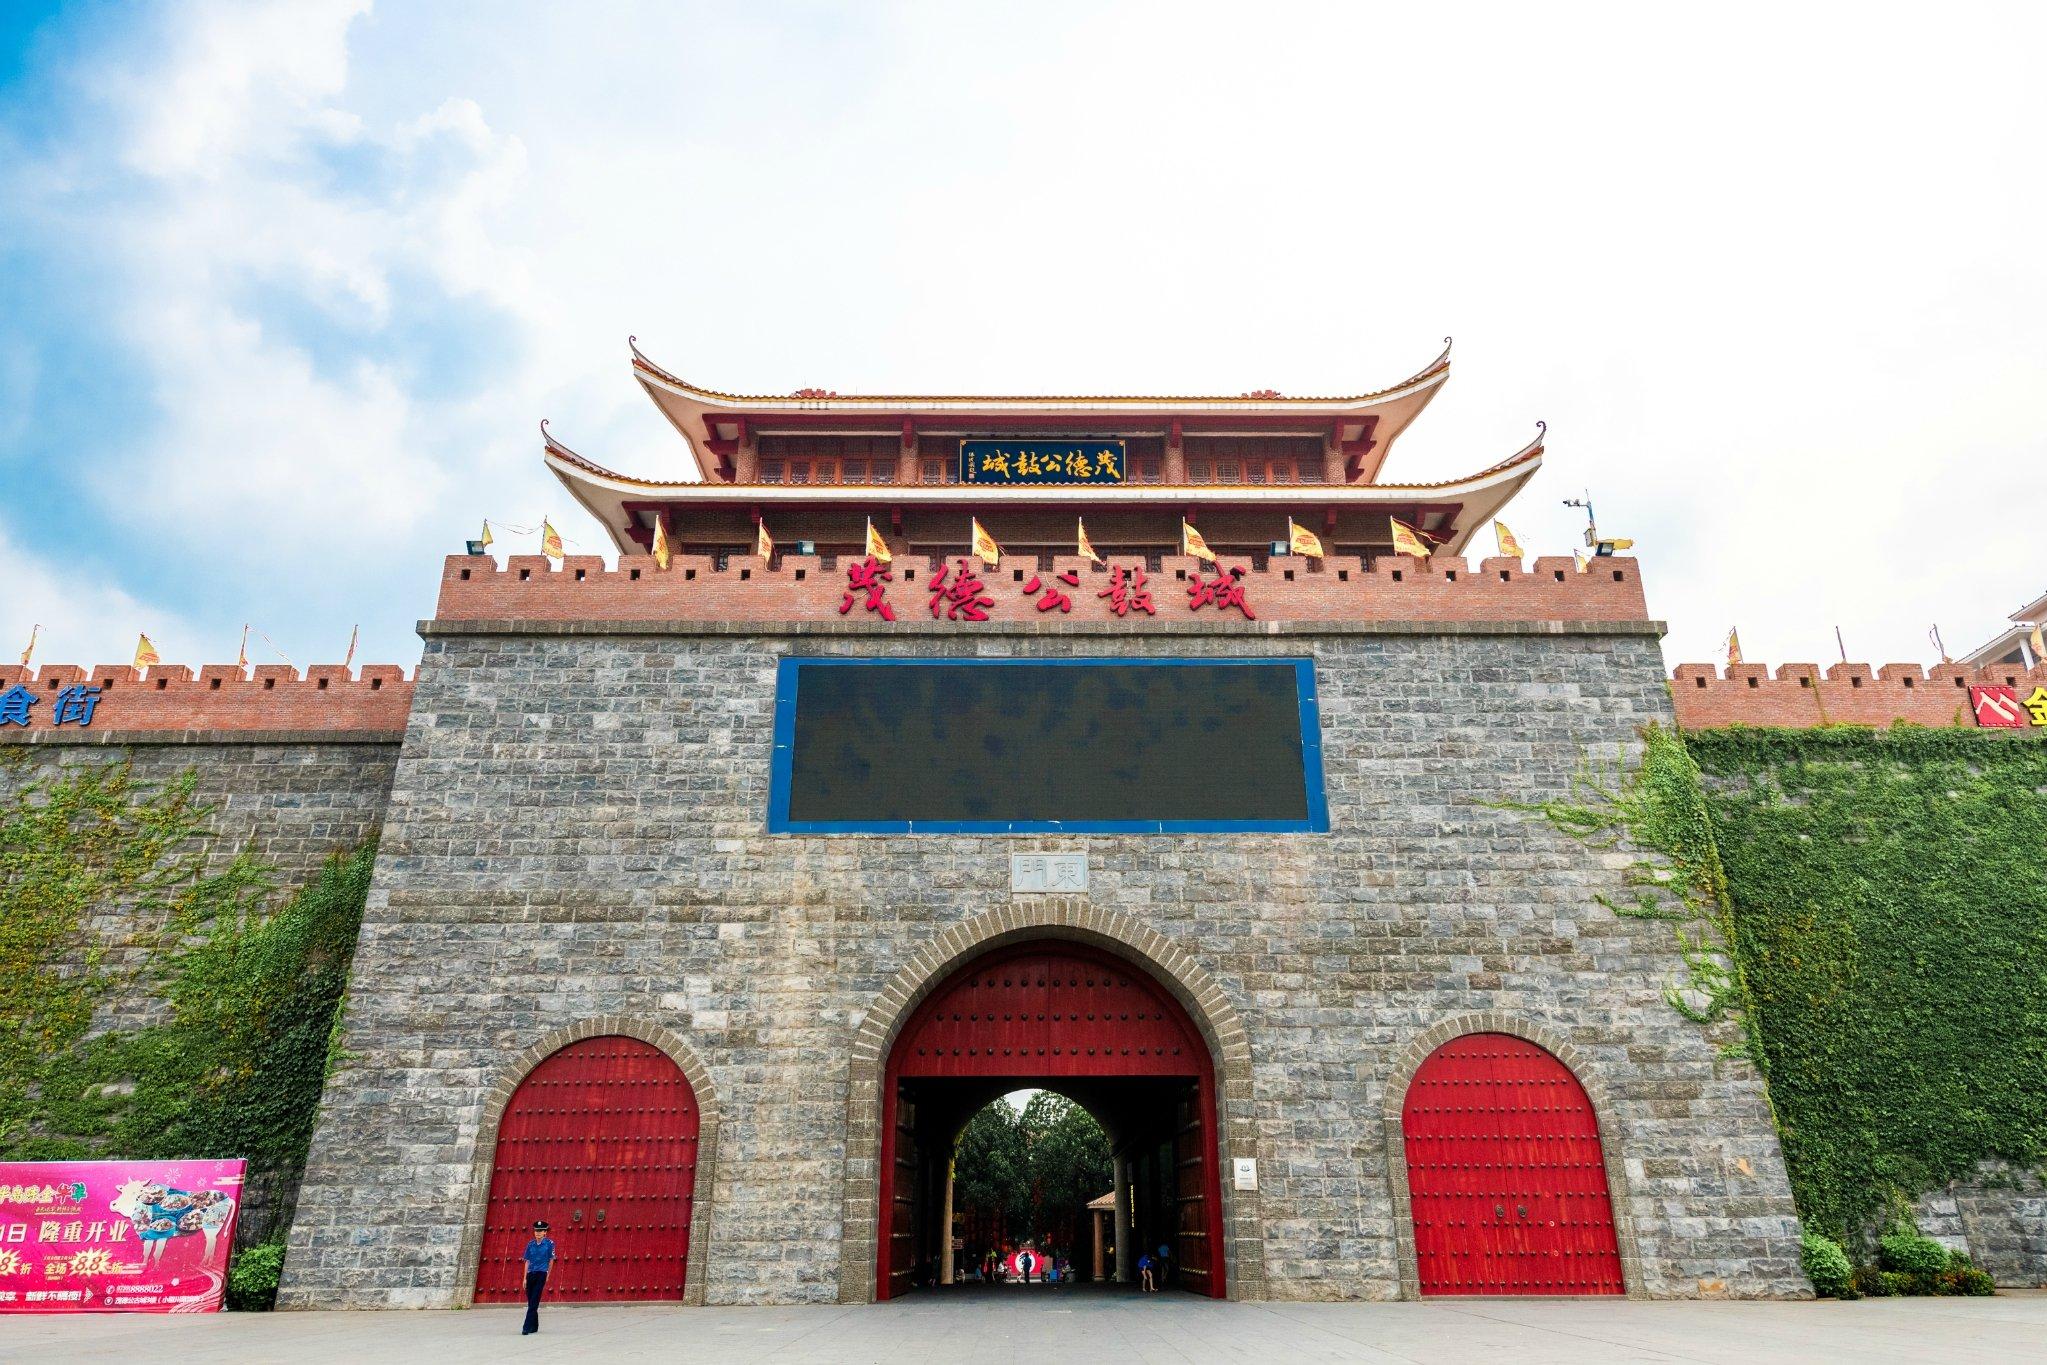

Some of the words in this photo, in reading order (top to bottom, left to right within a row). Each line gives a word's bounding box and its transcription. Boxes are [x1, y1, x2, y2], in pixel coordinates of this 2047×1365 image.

[982, 449, 1121, 479] 茂德公鼓城
[839, 555, 1256, 621] 茂德公鼓城
[0, 683, 101, 726] 食街
[38, 1220, 130, 1243] 隆重开业
